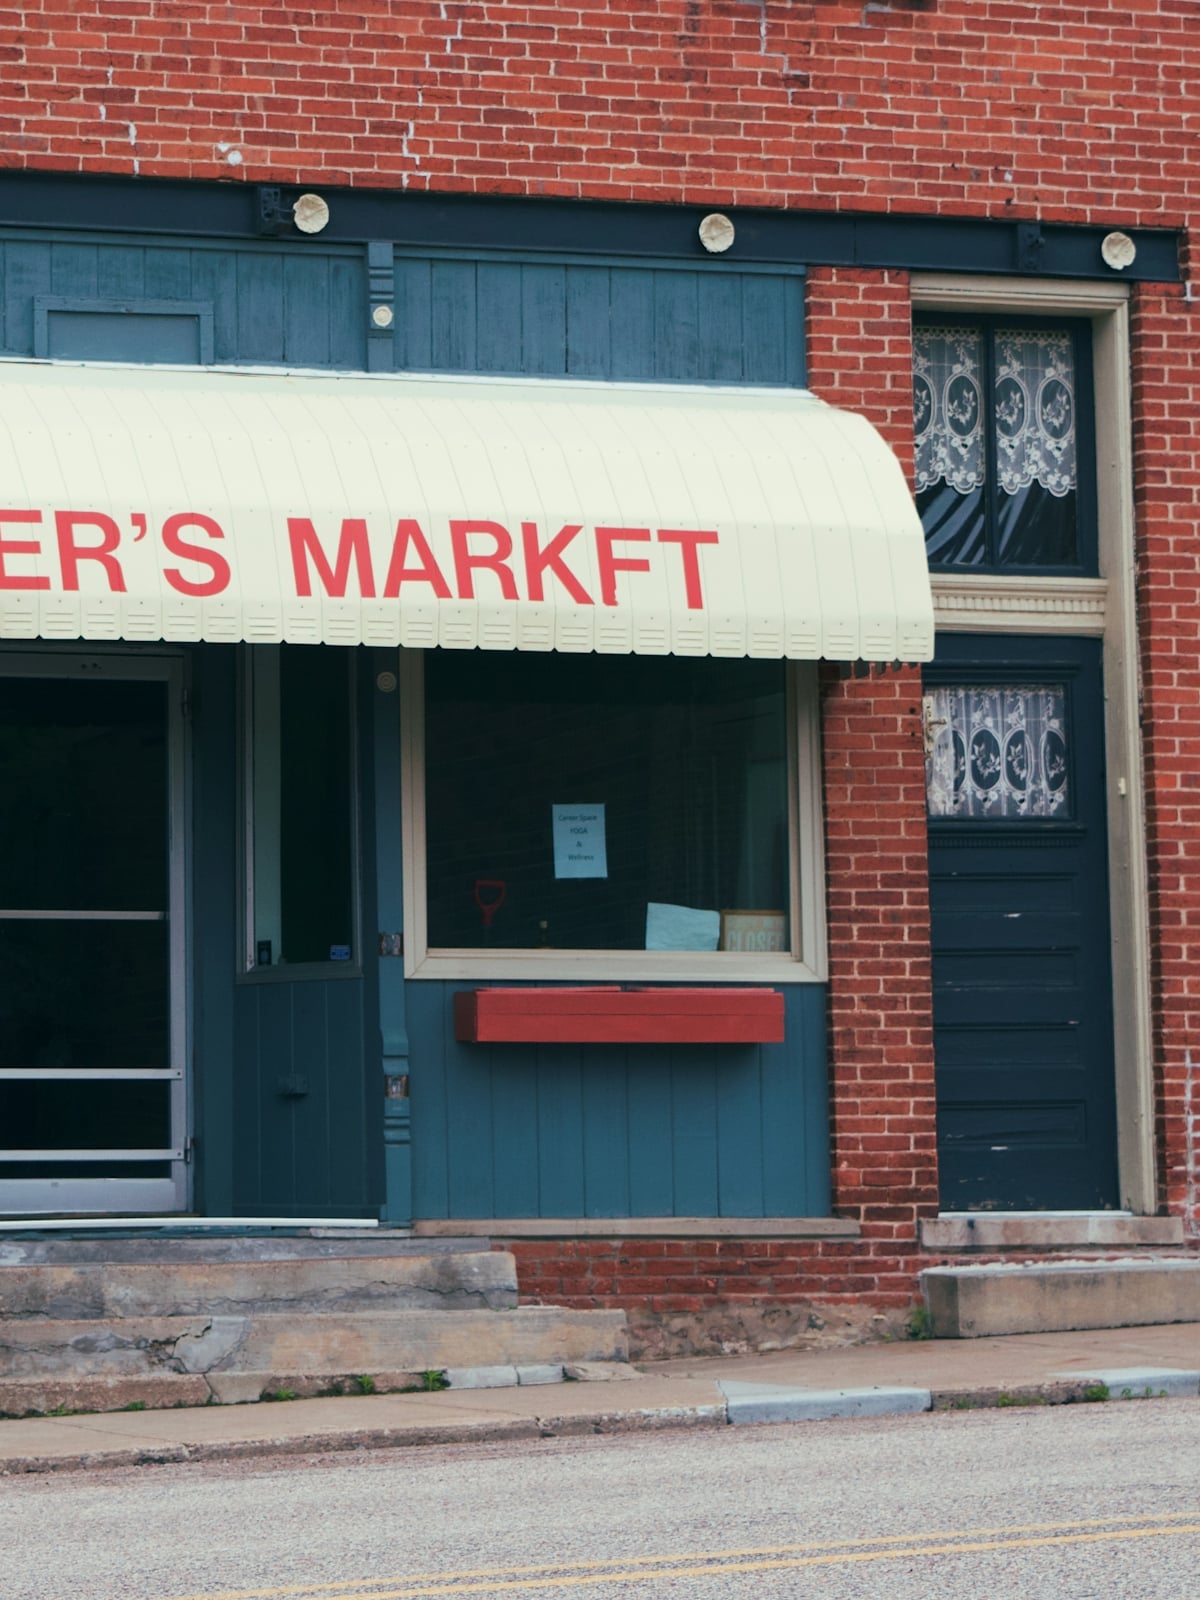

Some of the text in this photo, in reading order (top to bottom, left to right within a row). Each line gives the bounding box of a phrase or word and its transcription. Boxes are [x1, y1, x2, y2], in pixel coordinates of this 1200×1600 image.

[569, 826, 589, 835] YOGA
[576, 840, 583, 848] &
[567, 853, 595, 861] Wellness
